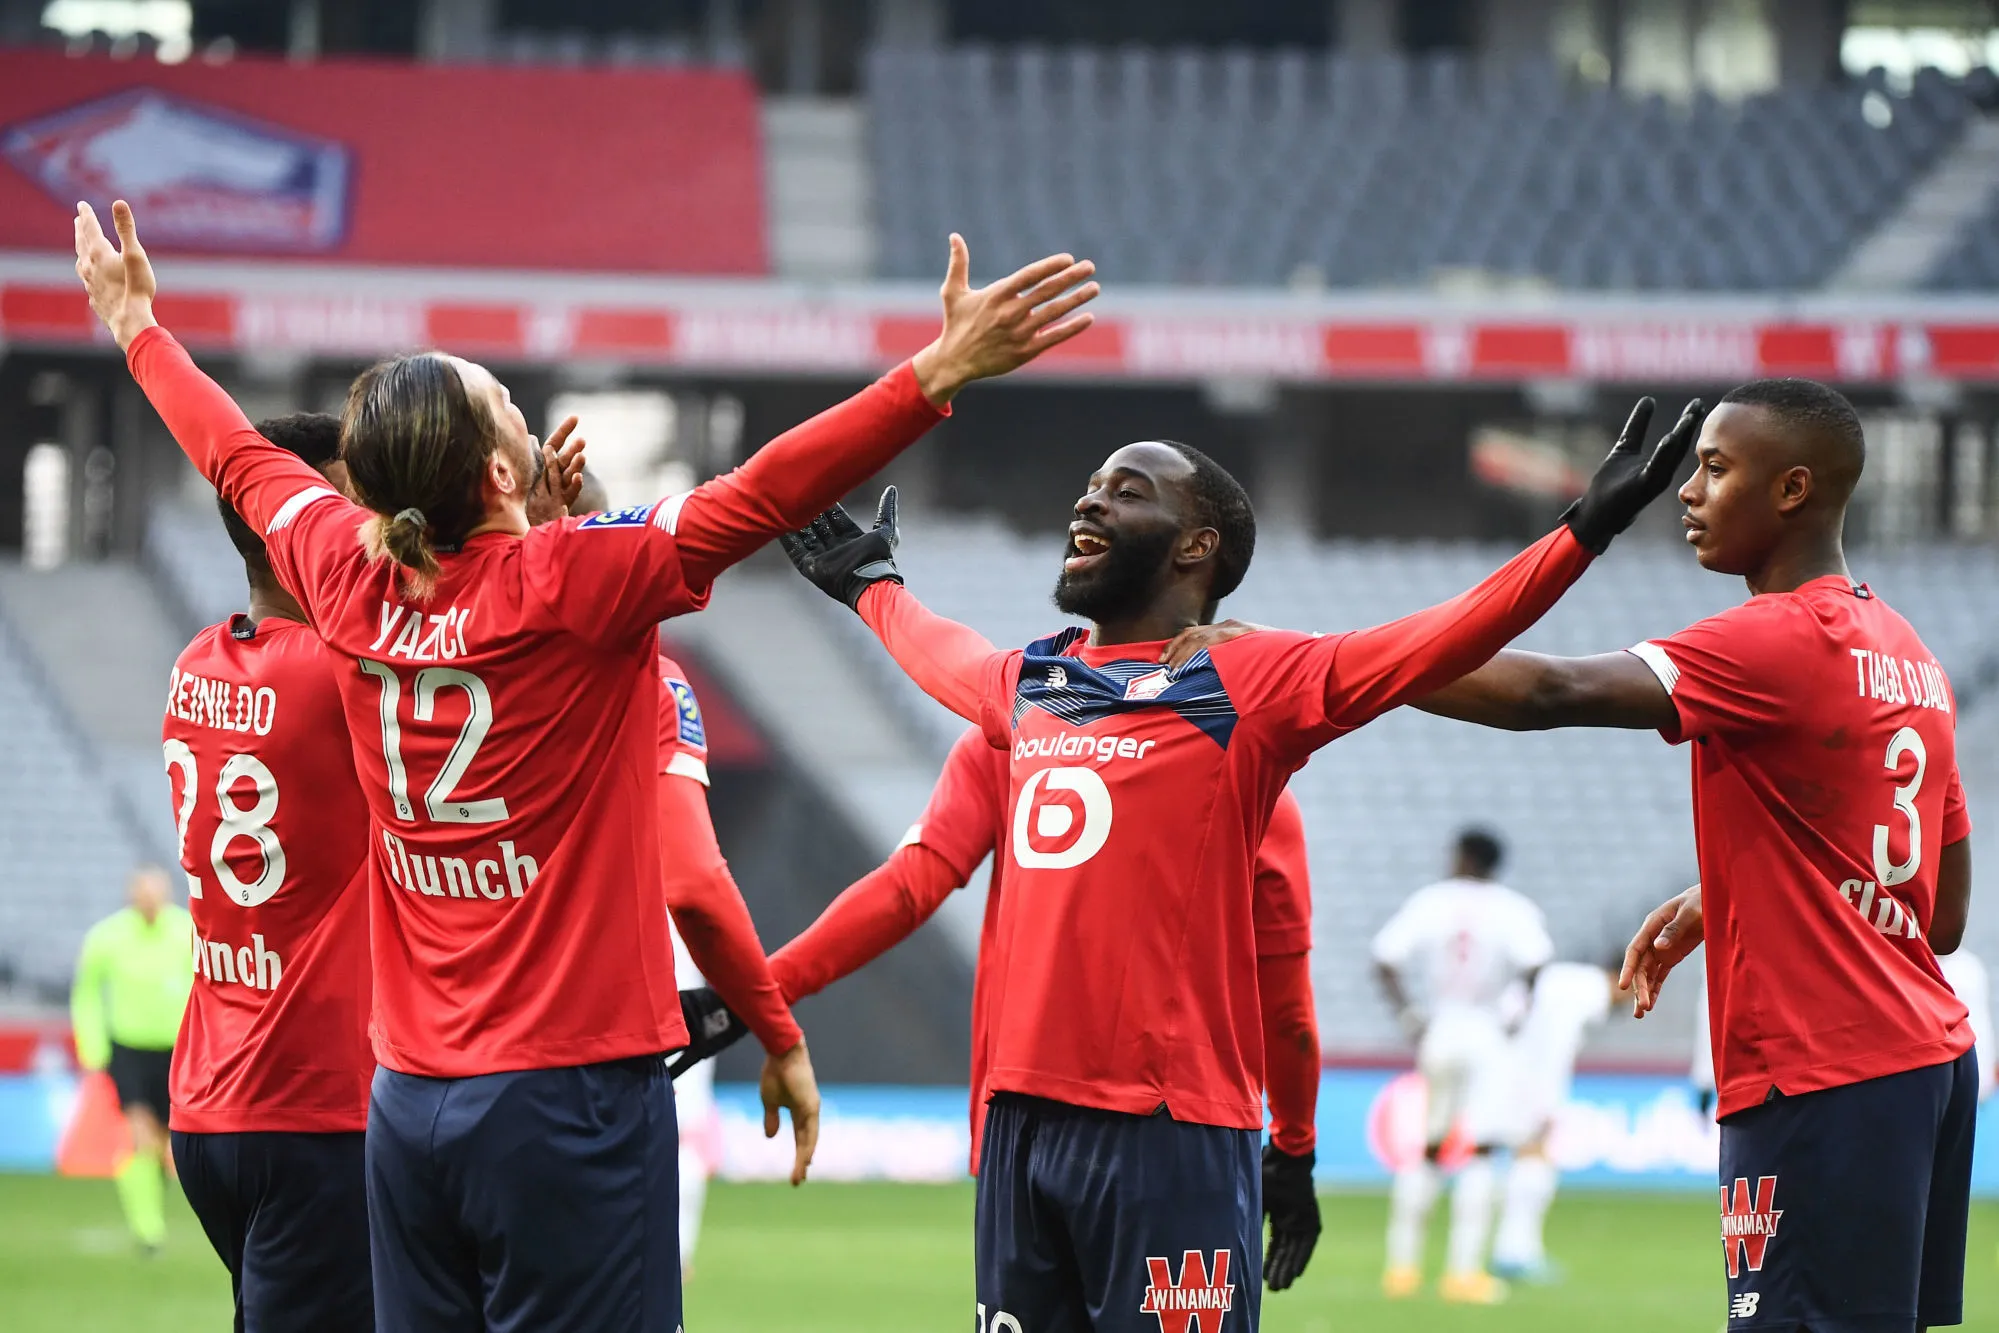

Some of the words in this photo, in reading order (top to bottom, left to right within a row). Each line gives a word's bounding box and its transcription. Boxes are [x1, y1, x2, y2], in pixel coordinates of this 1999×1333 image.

[165, 666, 277, 737] REINILDO
[1850, 648, 1907, 705] TIAGO
[358, 657, 510, 823] 12
[1014, 731, 1156, 763] boulanger
[162, 738, 288, 908] 28
[1873, 727, 1927, 887] 3
[382, 828, 540, 901] flunch
[192, 921, 282, 991] unch
[1722, 1213, 1774, 1237] WINAMAX
[1151, 1287, 1229, 1310] WINAMAX
